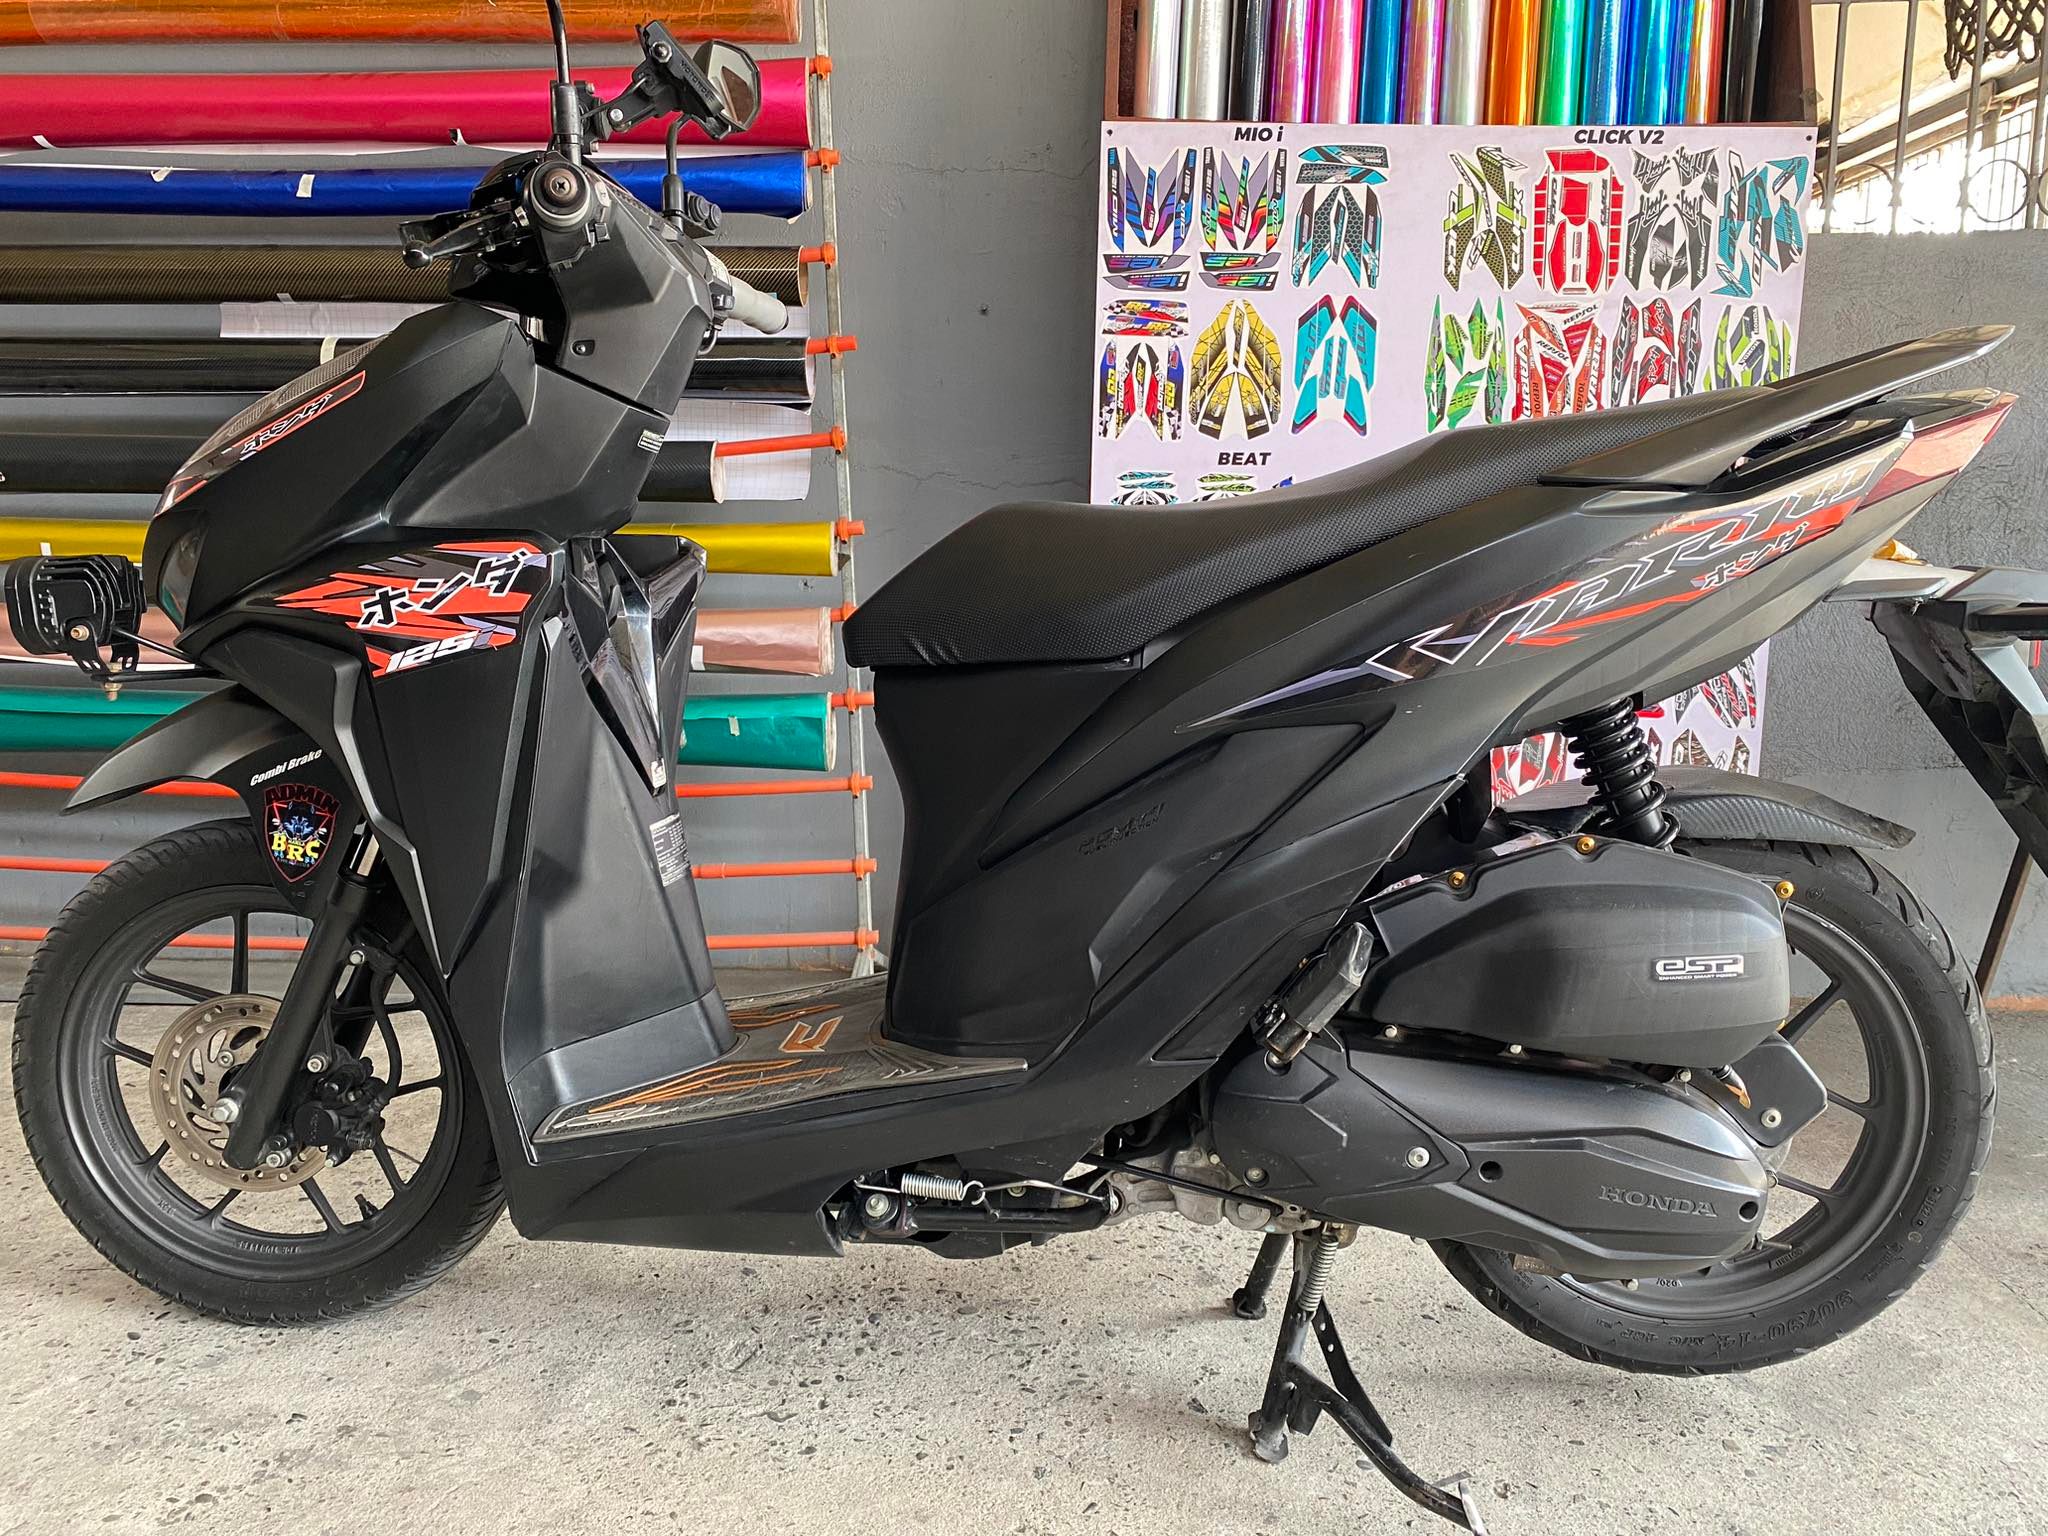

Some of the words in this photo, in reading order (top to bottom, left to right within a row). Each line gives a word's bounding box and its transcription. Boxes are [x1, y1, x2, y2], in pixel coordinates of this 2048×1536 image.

[1234, 126, 1273, 142] MIO
[1277, 125, 1284, 142] i
[1574, 128, 1633, 145] CLICK
[1638, 129, 1665, 145] V2
[1217, 452, 1272, 466] BEAT
[1700, 521, 1810, 590] ホンダ
[355, 548, 533, 629] ホンダ
[250, 761, 288, 787] Combi
[287, 749, 322, 771] Brake
[264, 783, 341, 817] ADMIN
[271, 832, 321, 862] BRC
[1599, 1185, 1719, 1219] HONDA
